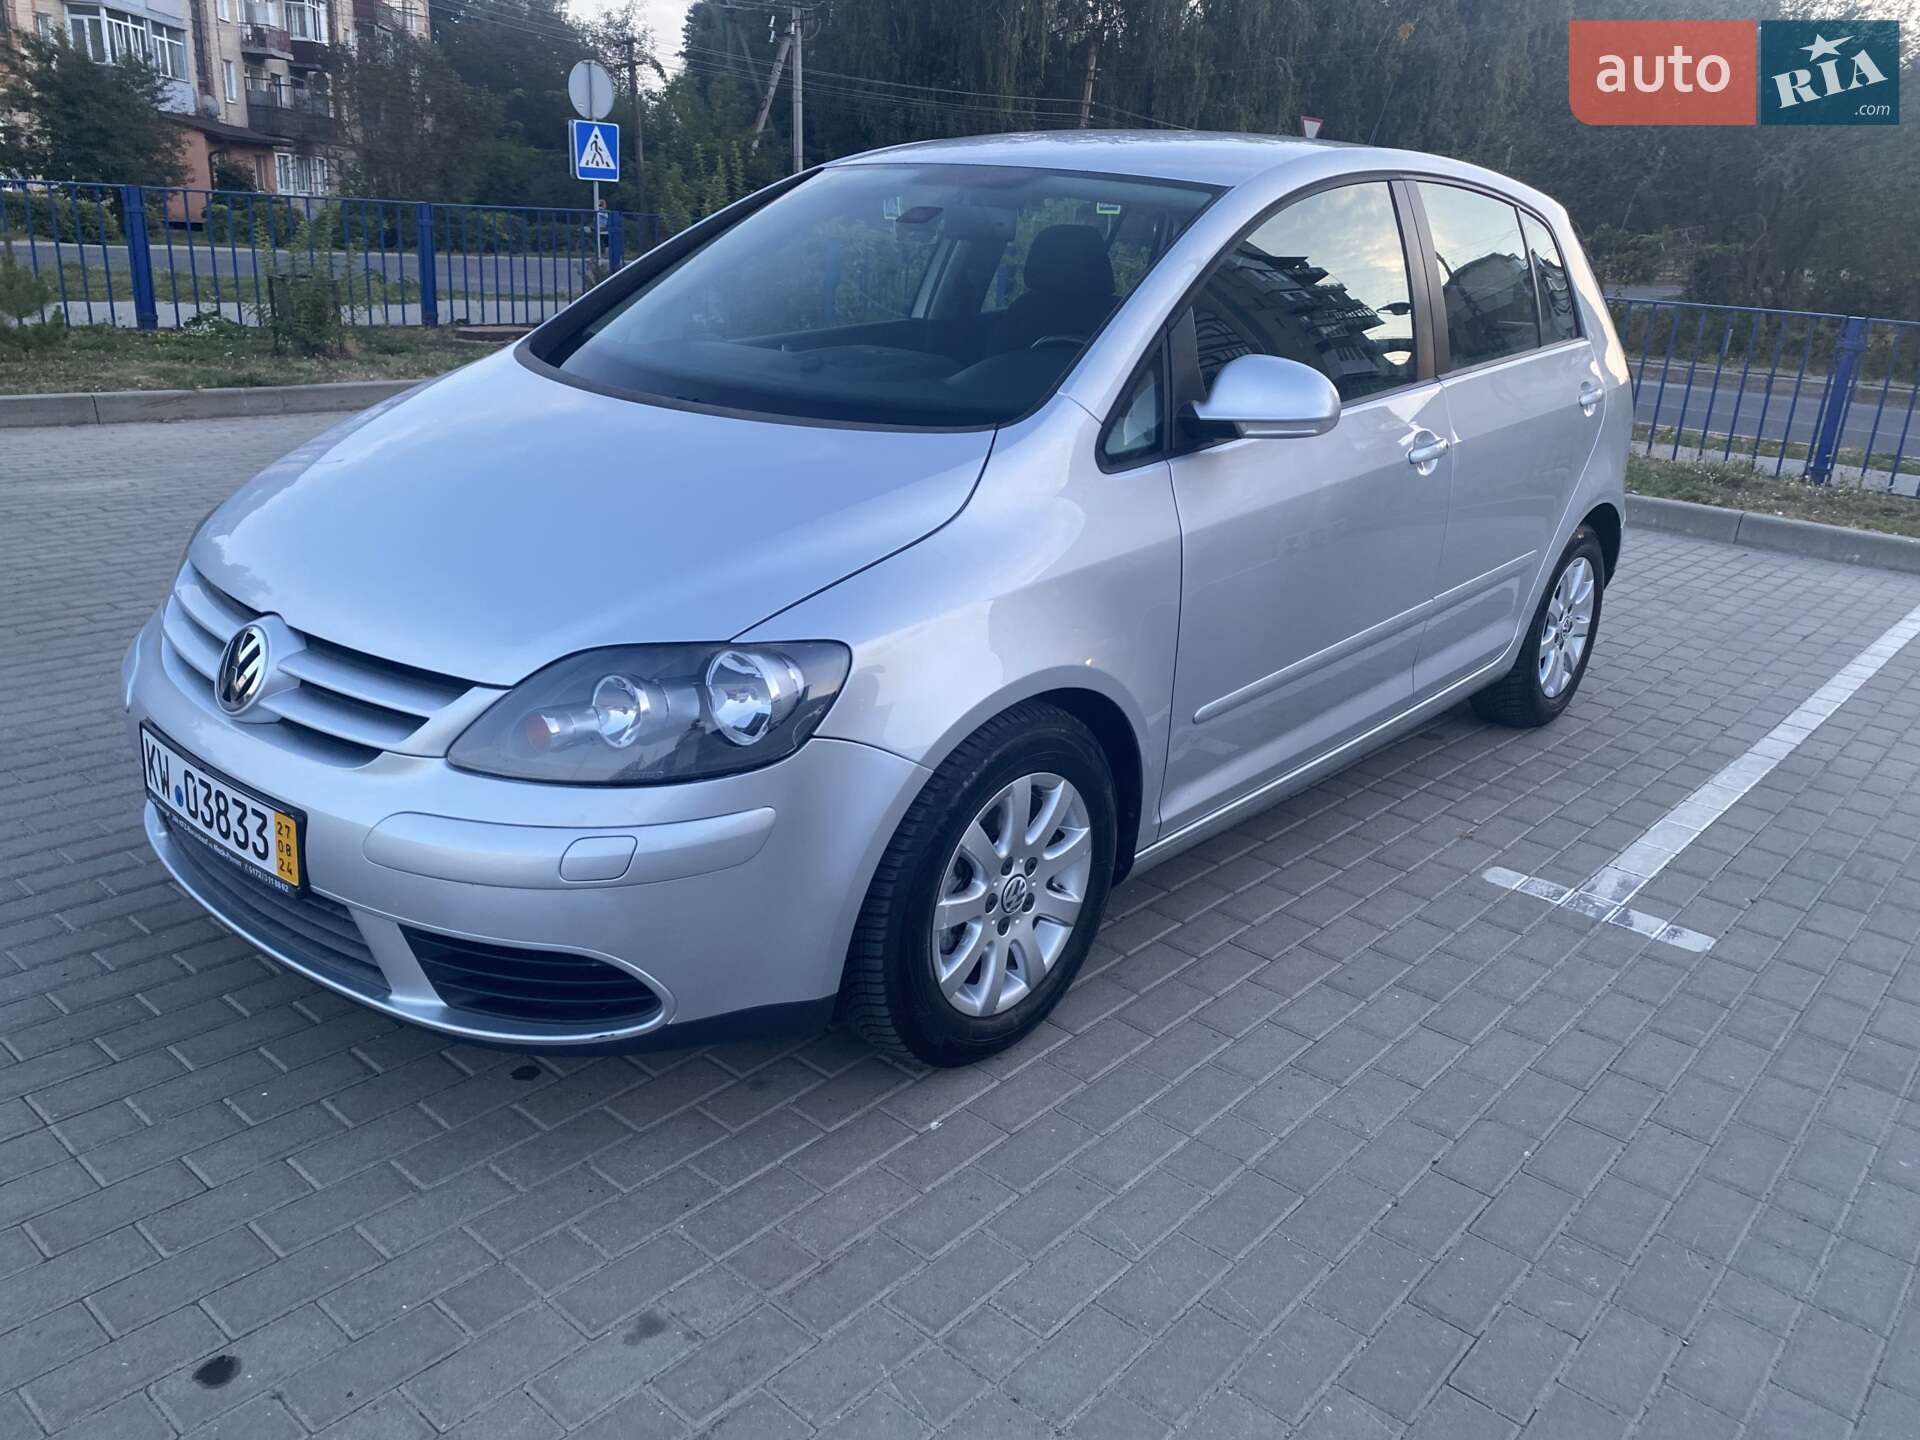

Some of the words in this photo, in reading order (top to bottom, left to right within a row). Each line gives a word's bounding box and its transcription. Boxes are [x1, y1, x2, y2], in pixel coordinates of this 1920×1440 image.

[145, 737, 170, 800] KW
[184, 769, 269, 861] 03833
[276, 821, 291, 839] 27
[277, 839, 292, 857] 08
[279, 857, 293, 876] 24
